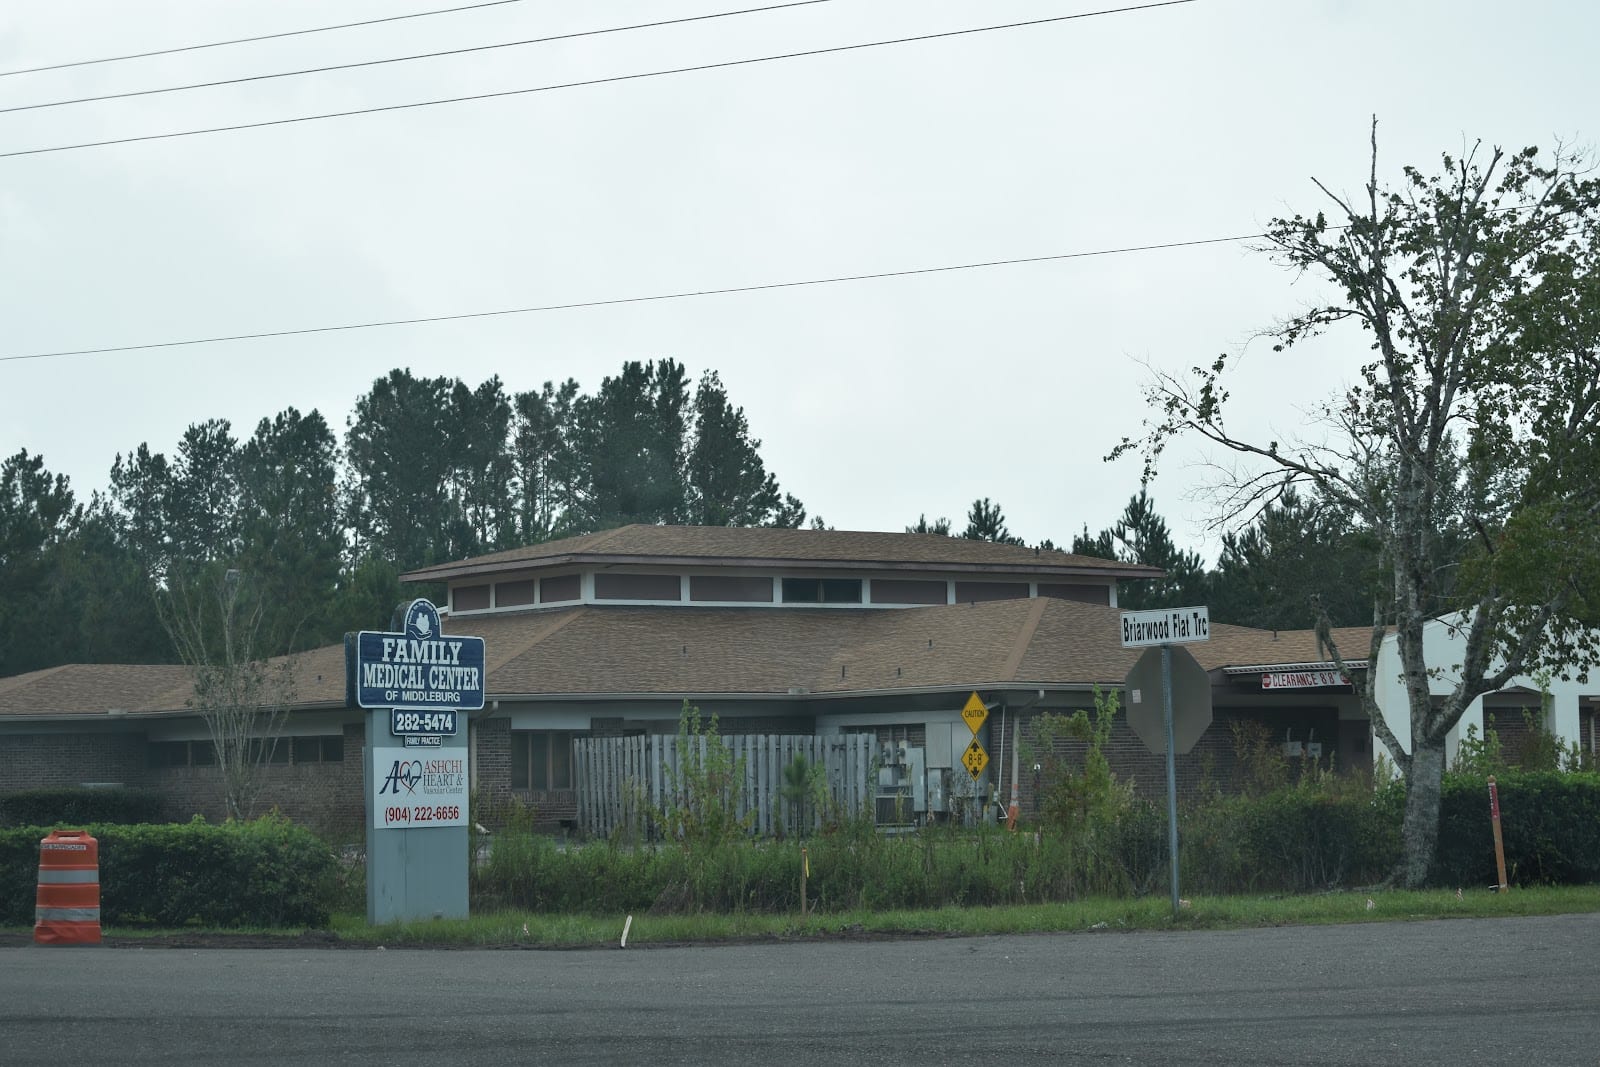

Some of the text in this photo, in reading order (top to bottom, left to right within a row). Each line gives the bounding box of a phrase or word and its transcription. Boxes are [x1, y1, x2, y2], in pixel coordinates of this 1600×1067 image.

[1123, 612, 1207, 642] Briarwood Flat Trc
[382, 639, 462, 665] FAMILY
[363, 663, 480, 691] MEDICAL CENTER
[1272, 672, 1318, 687] CLEARANCE
[385, 690, 460, 702] OF MIDDLEBURG
[964, 710, 984, 718] CAUTION
[396, 713, 453, 731] 282-5474
[406, 736, 441, 745] FAMILY PRACTICE
[423, 760, 463, 774] ASHCHI
[423, 774, 463, 786] HEART &
[446, 786, 463, 794] Center
[385, 806, 459, 825] (904) 222-6656
